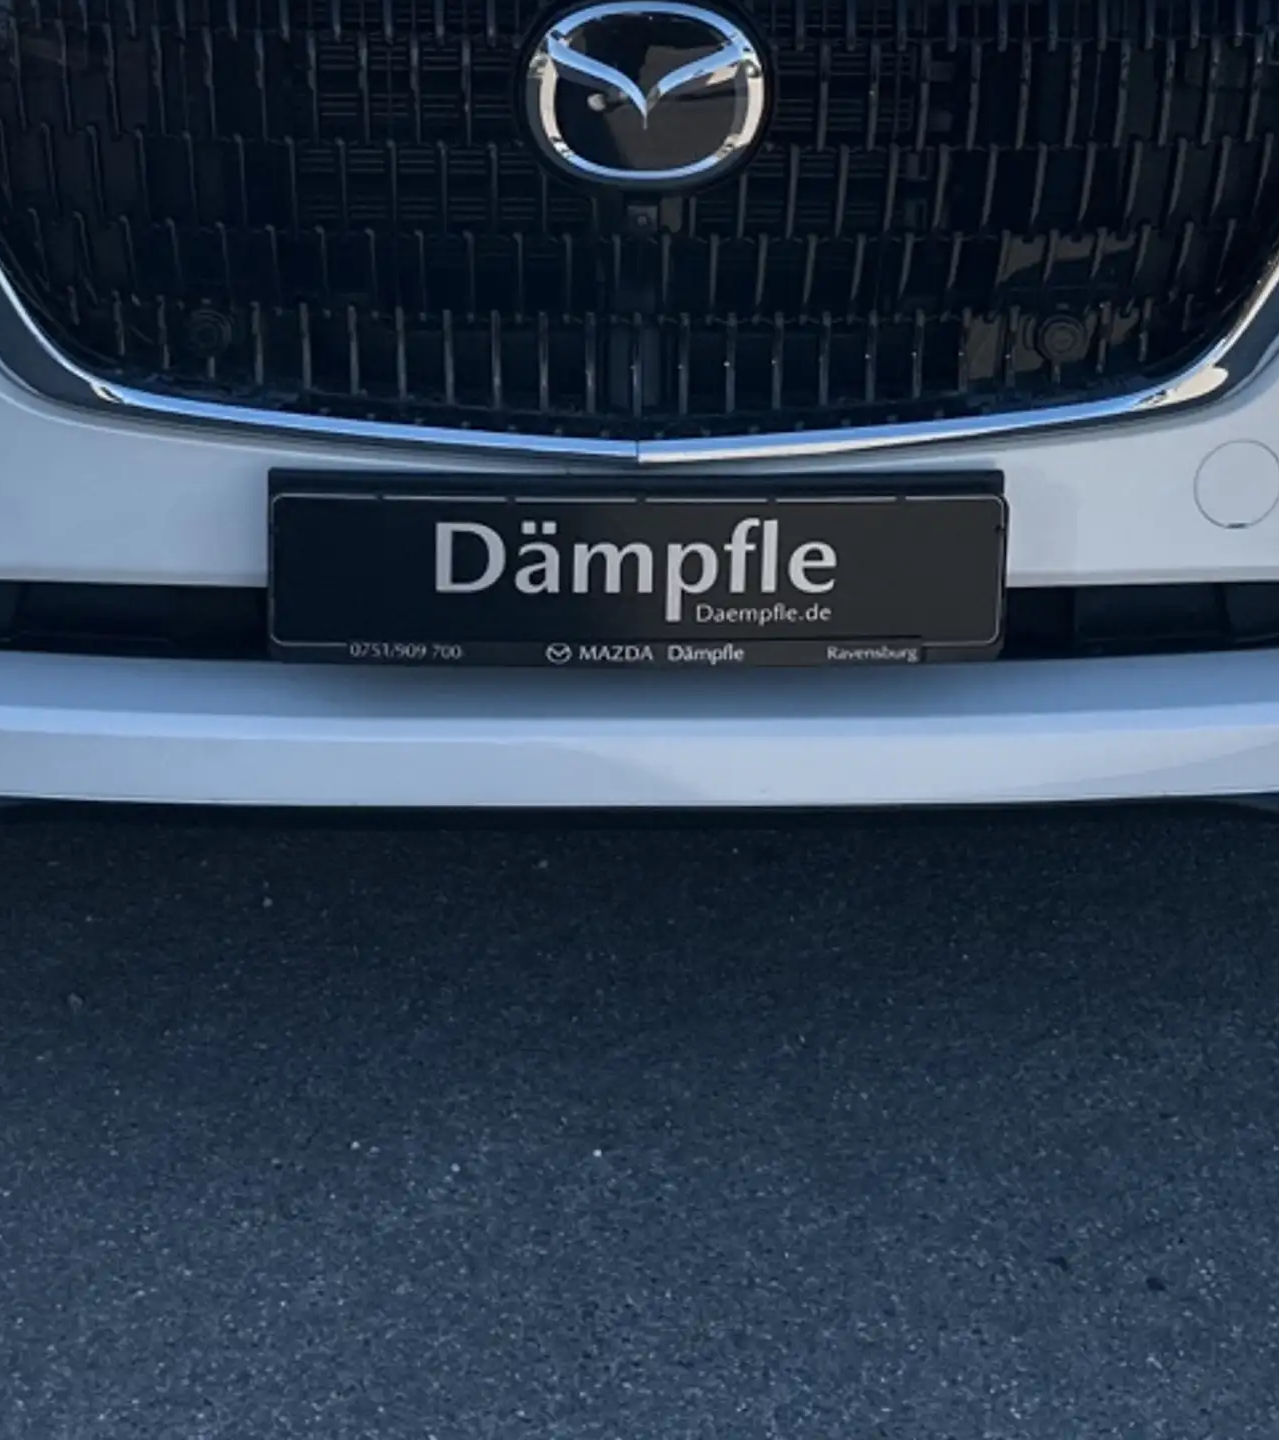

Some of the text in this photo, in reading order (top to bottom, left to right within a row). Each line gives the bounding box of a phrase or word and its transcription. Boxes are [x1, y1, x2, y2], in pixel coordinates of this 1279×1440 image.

[435, 517, 838, 623] Dämpfle
[695, 602, 833, 627] Daempfle.de
[578, 644, 745, 665] MAZDA Dämpfle
[826, 645, 918, 663] Ravensburg
